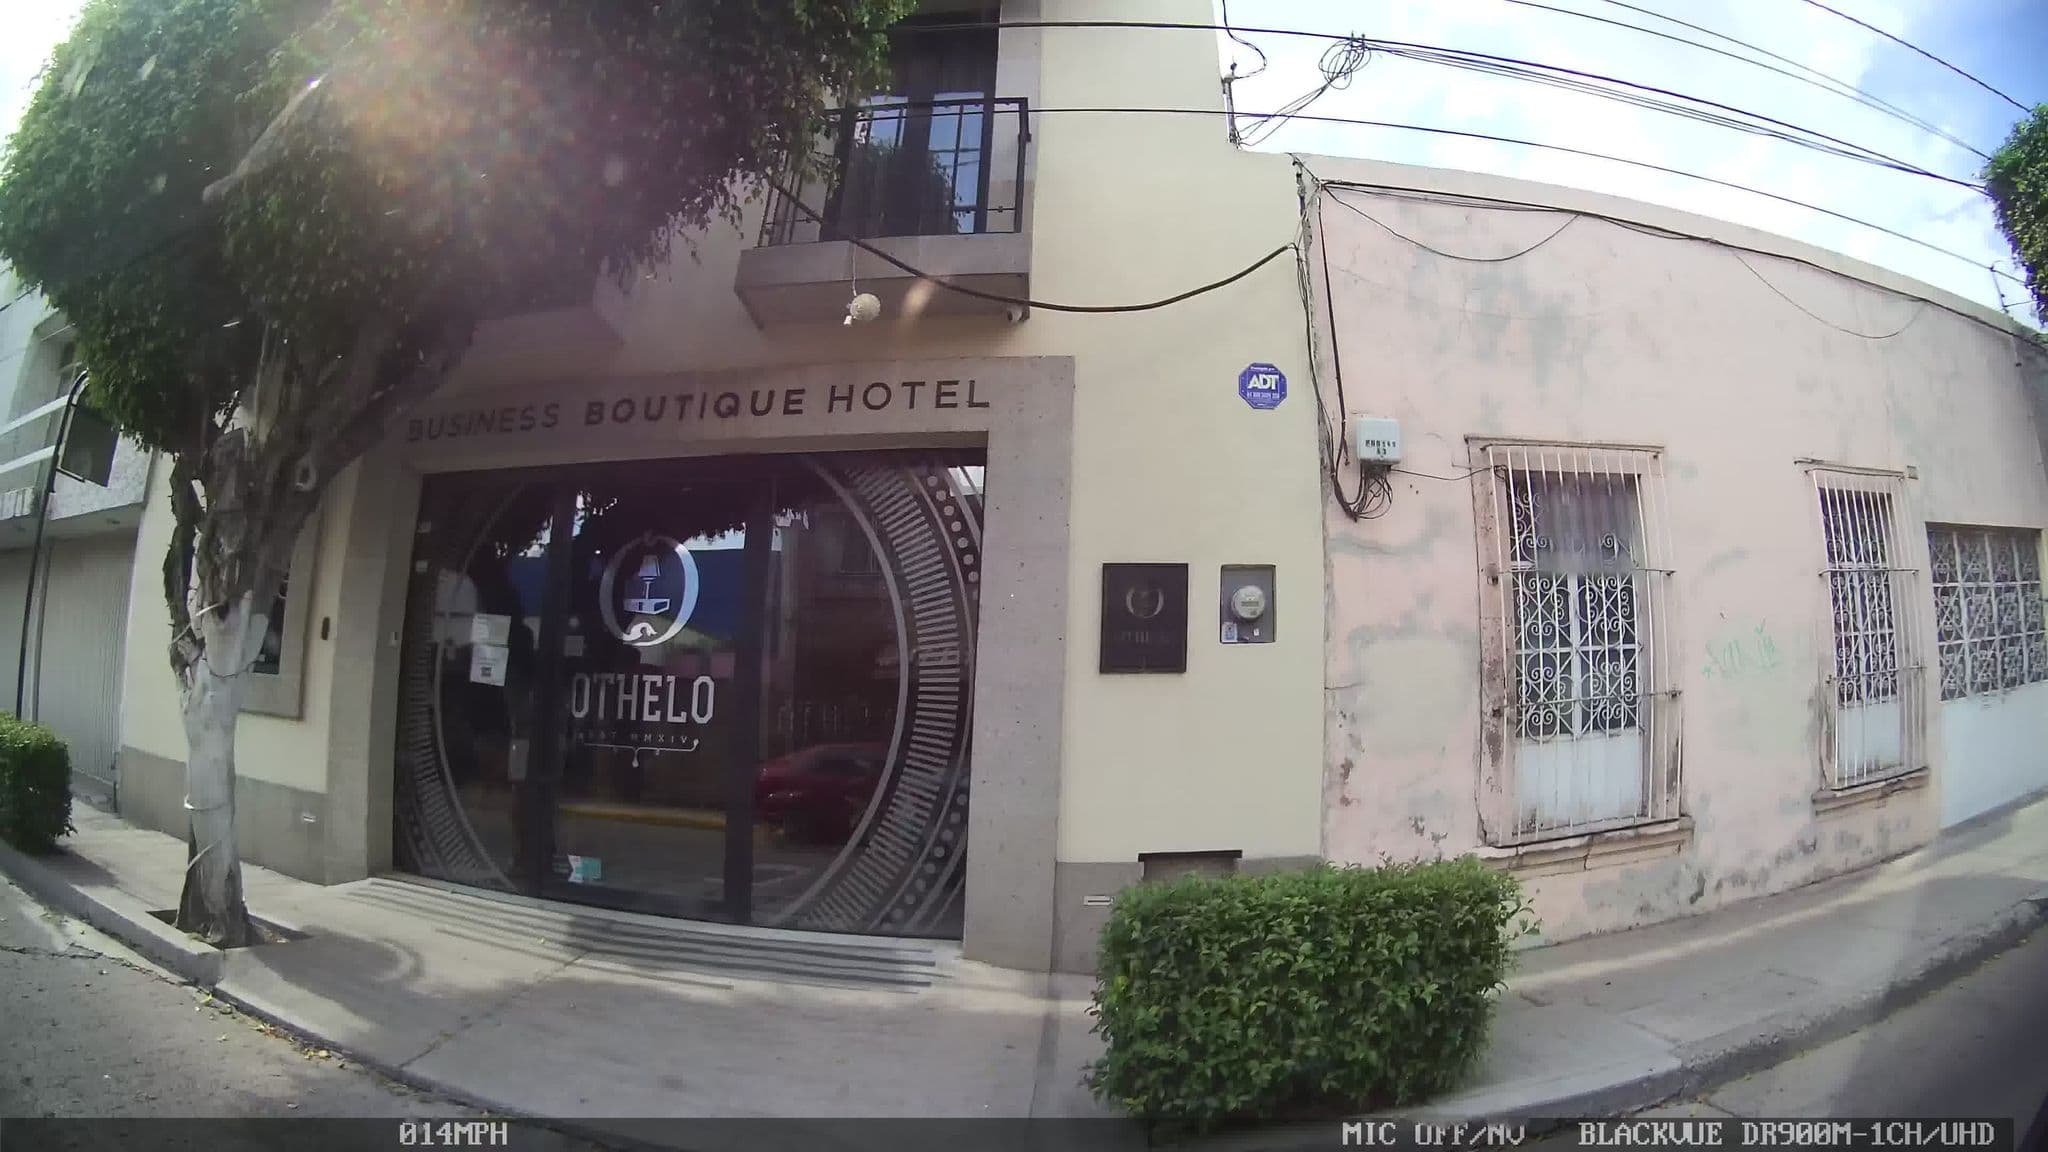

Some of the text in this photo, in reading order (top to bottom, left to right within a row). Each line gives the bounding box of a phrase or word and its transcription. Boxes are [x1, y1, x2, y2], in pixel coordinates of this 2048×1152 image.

[1247, 374, 1279, 390] ADT
[407, 379, 991, 442] BUSINESS BOUTIQUE HOTEL
[570, 672, 715, 724] OTHELO
